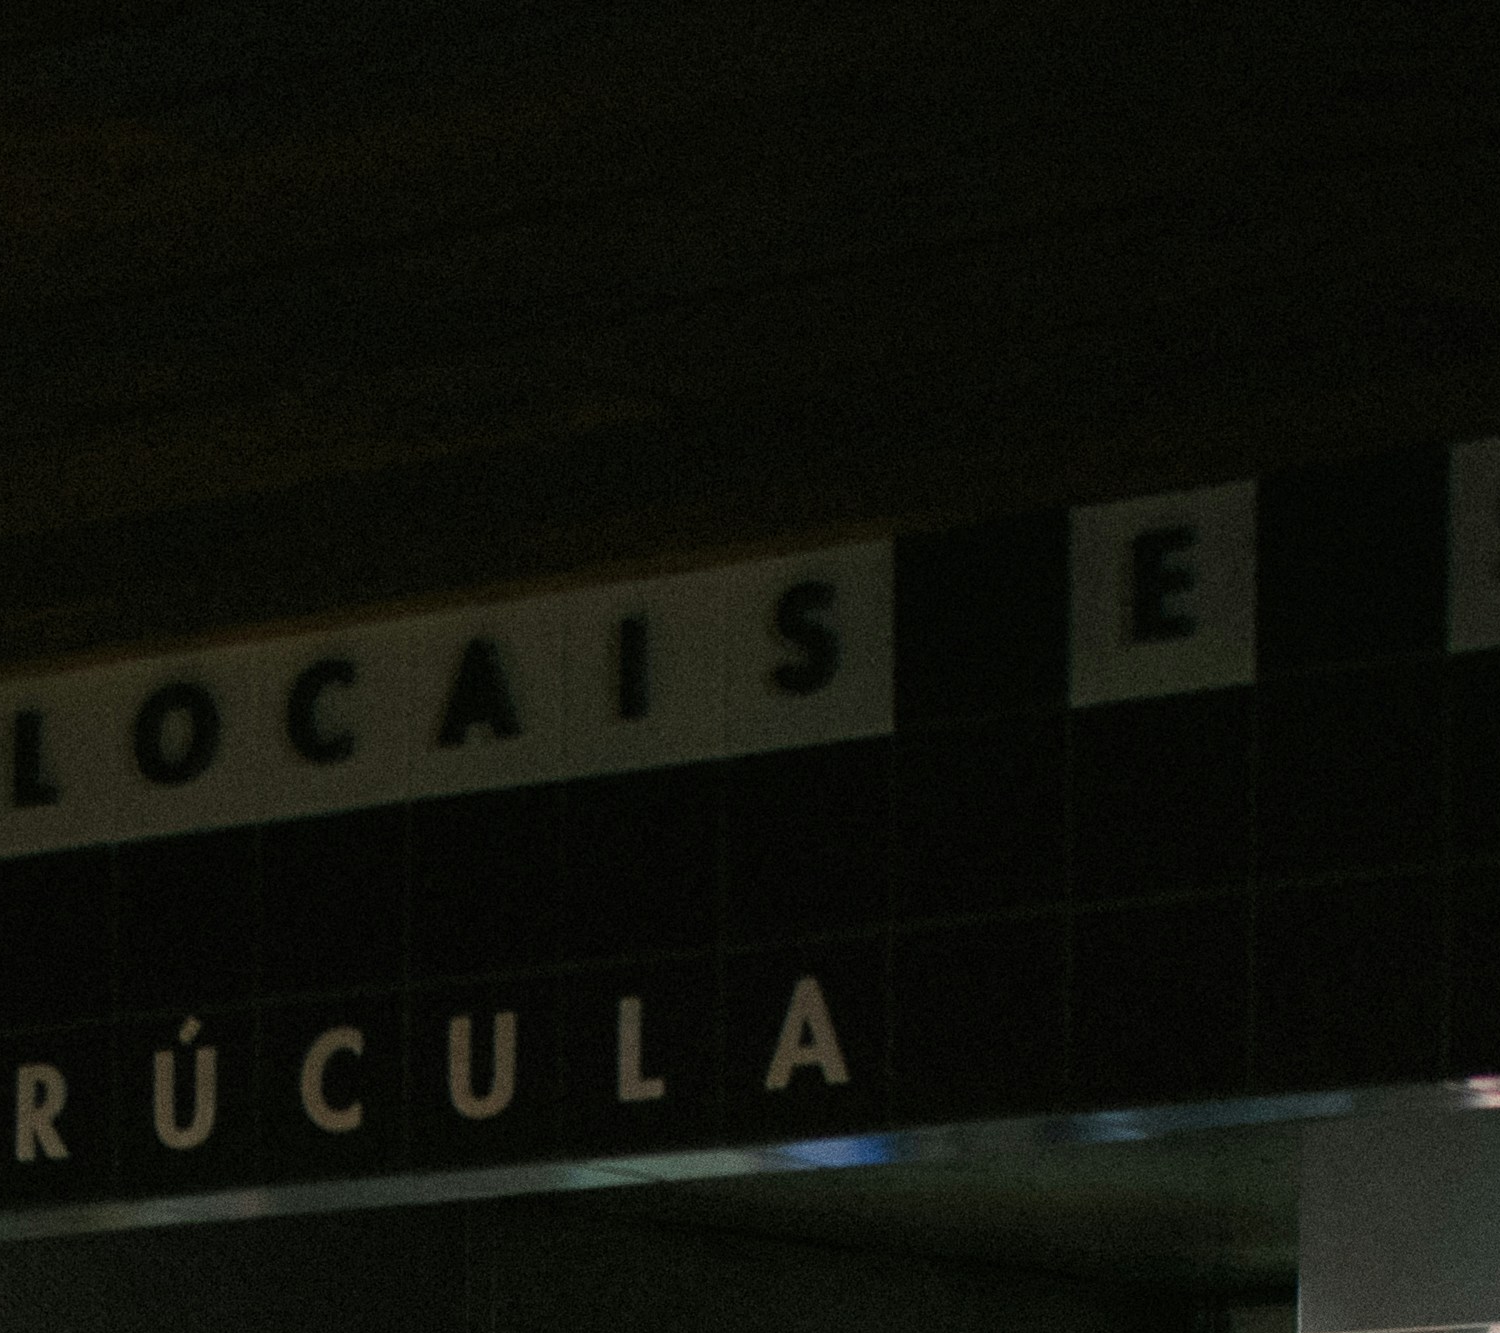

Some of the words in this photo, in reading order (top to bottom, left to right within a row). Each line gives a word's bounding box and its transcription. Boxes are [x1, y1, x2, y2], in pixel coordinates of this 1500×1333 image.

[11, 579, 843, 808] LOCAIS
[1125, 525, 1200, 645] E
[15, 981, 846, 1161] RÚCULA
